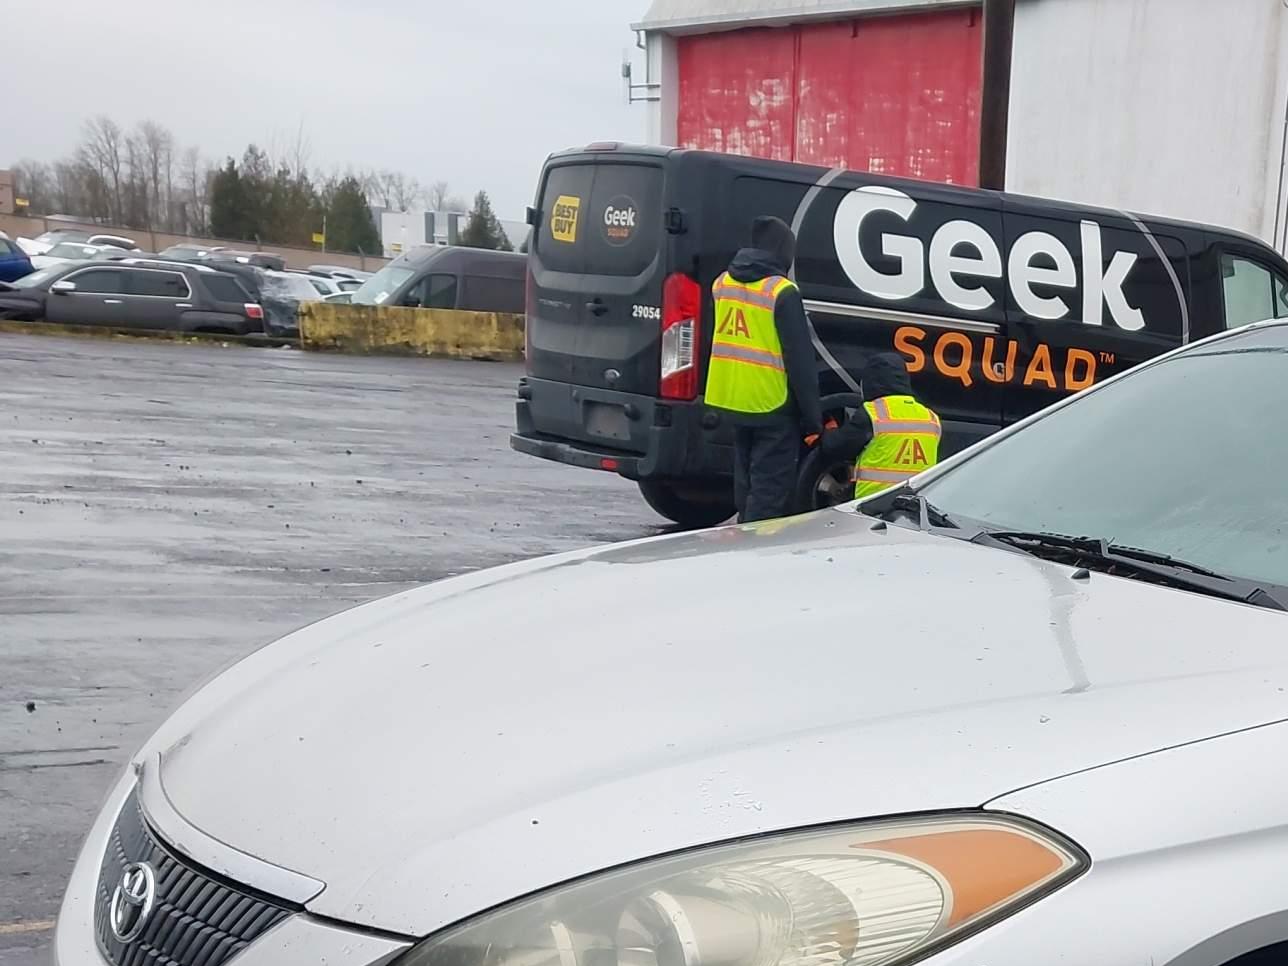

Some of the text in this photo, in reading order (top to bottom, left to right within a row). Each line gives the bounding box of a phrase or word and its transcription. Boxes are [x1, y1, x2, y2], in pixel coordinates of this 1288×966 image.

[554, 204, 578, 220] BEST
[604, 206, 636, 226] Geek
[553, 219, 575, 234] BUY
[834, 186, 1146, 332] Geek
[632, 304, 661, 319] 29054
[893, 326, 1097, 391] SQUAD
